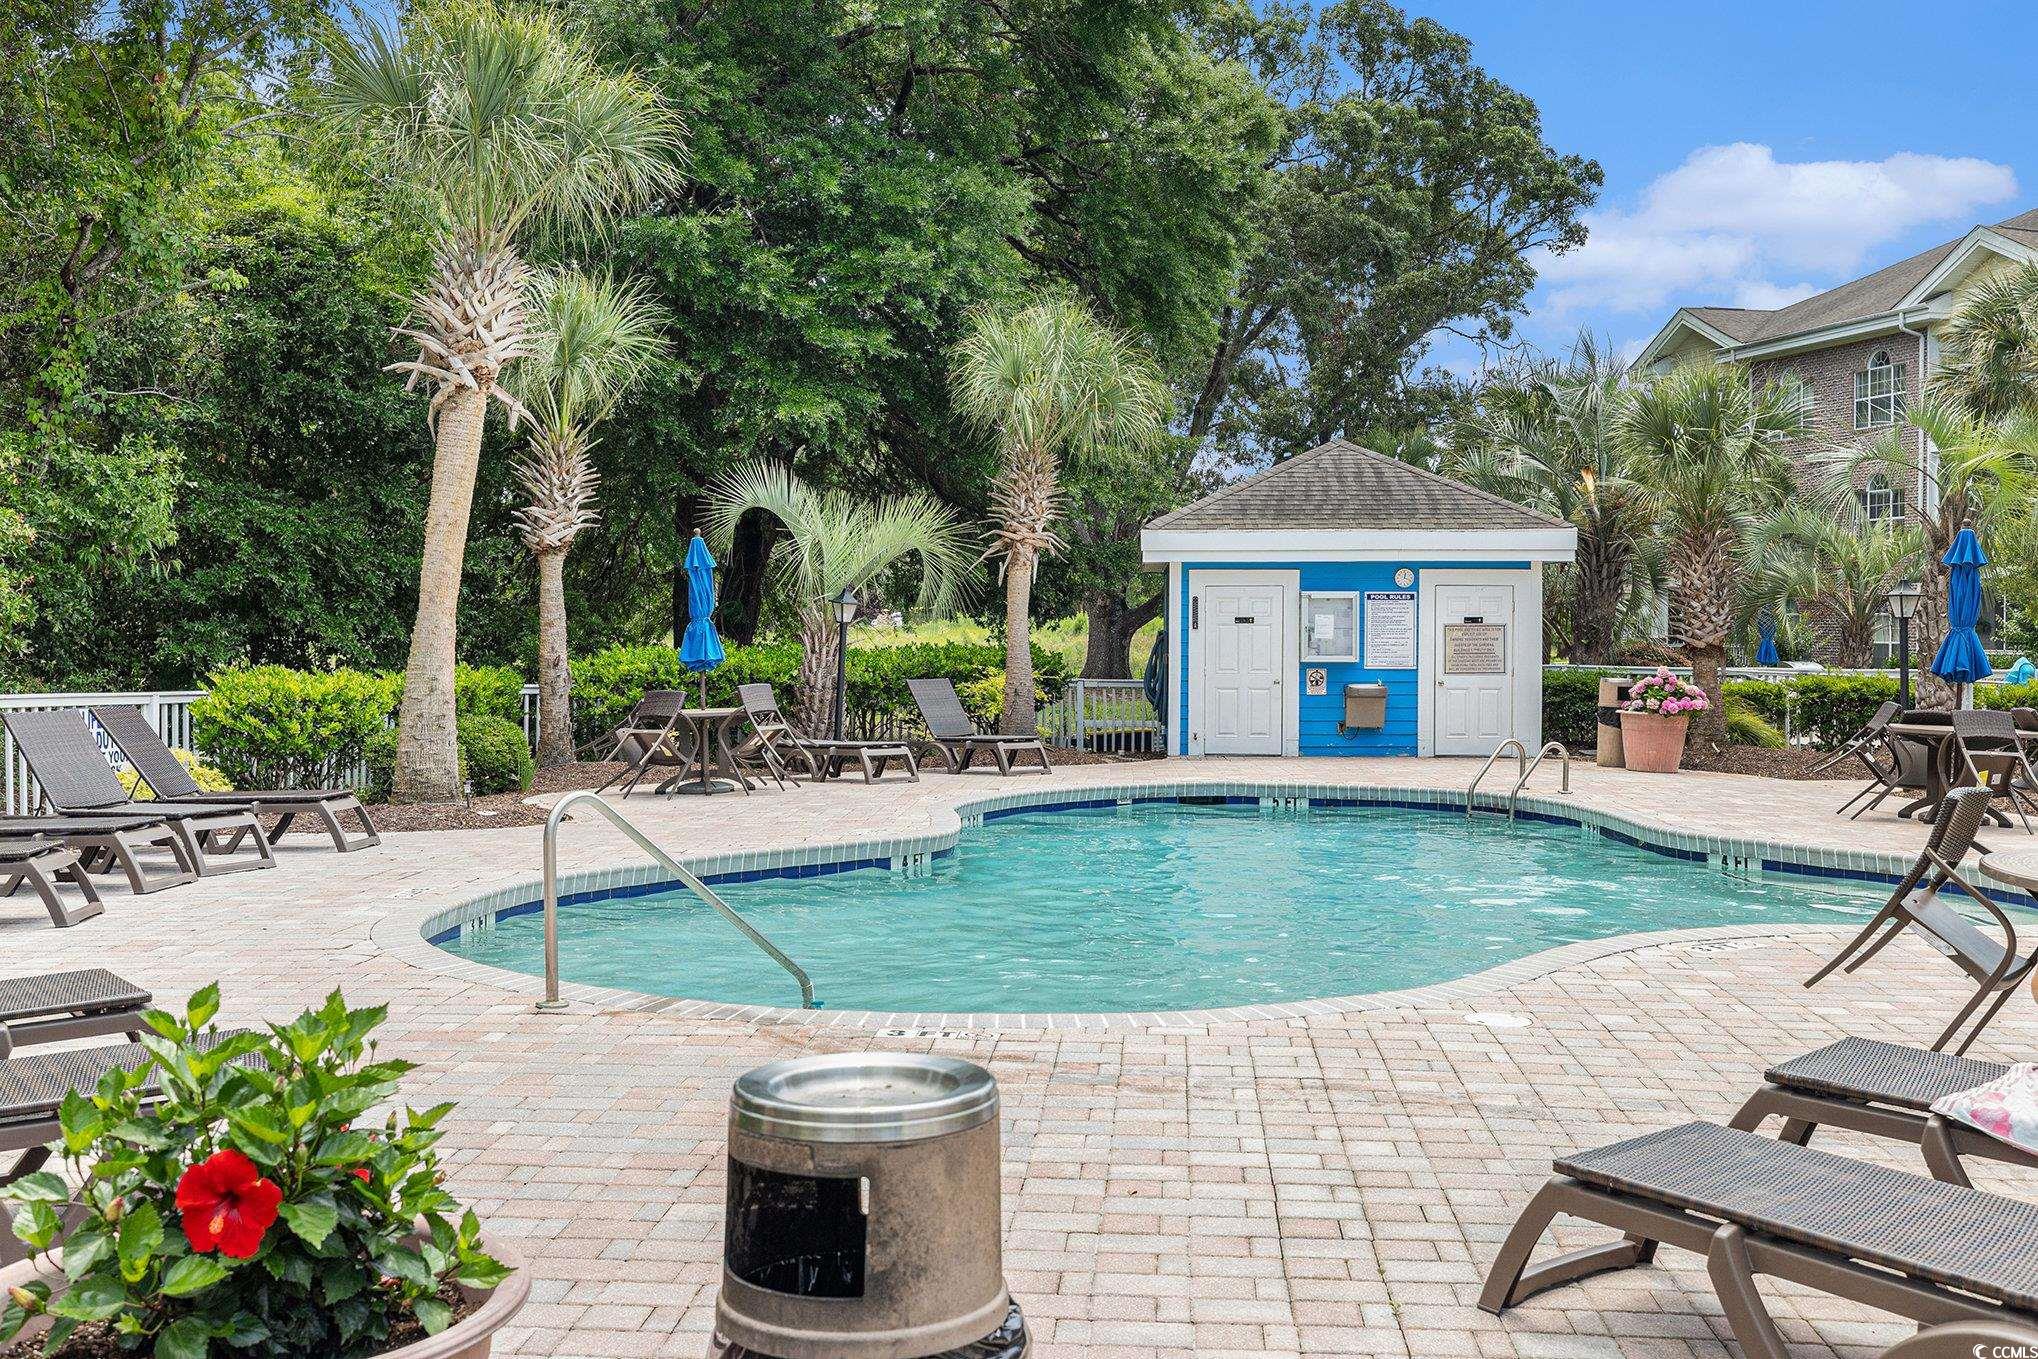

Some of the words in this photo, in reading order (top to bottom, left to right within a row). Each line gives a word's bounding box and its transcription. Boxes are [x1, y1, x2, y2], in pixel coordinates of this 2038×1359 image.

[902, 854, 908, 867] 4
[913, 852, 924, 865] FT
[1721, 854, 1729, 866] 4
